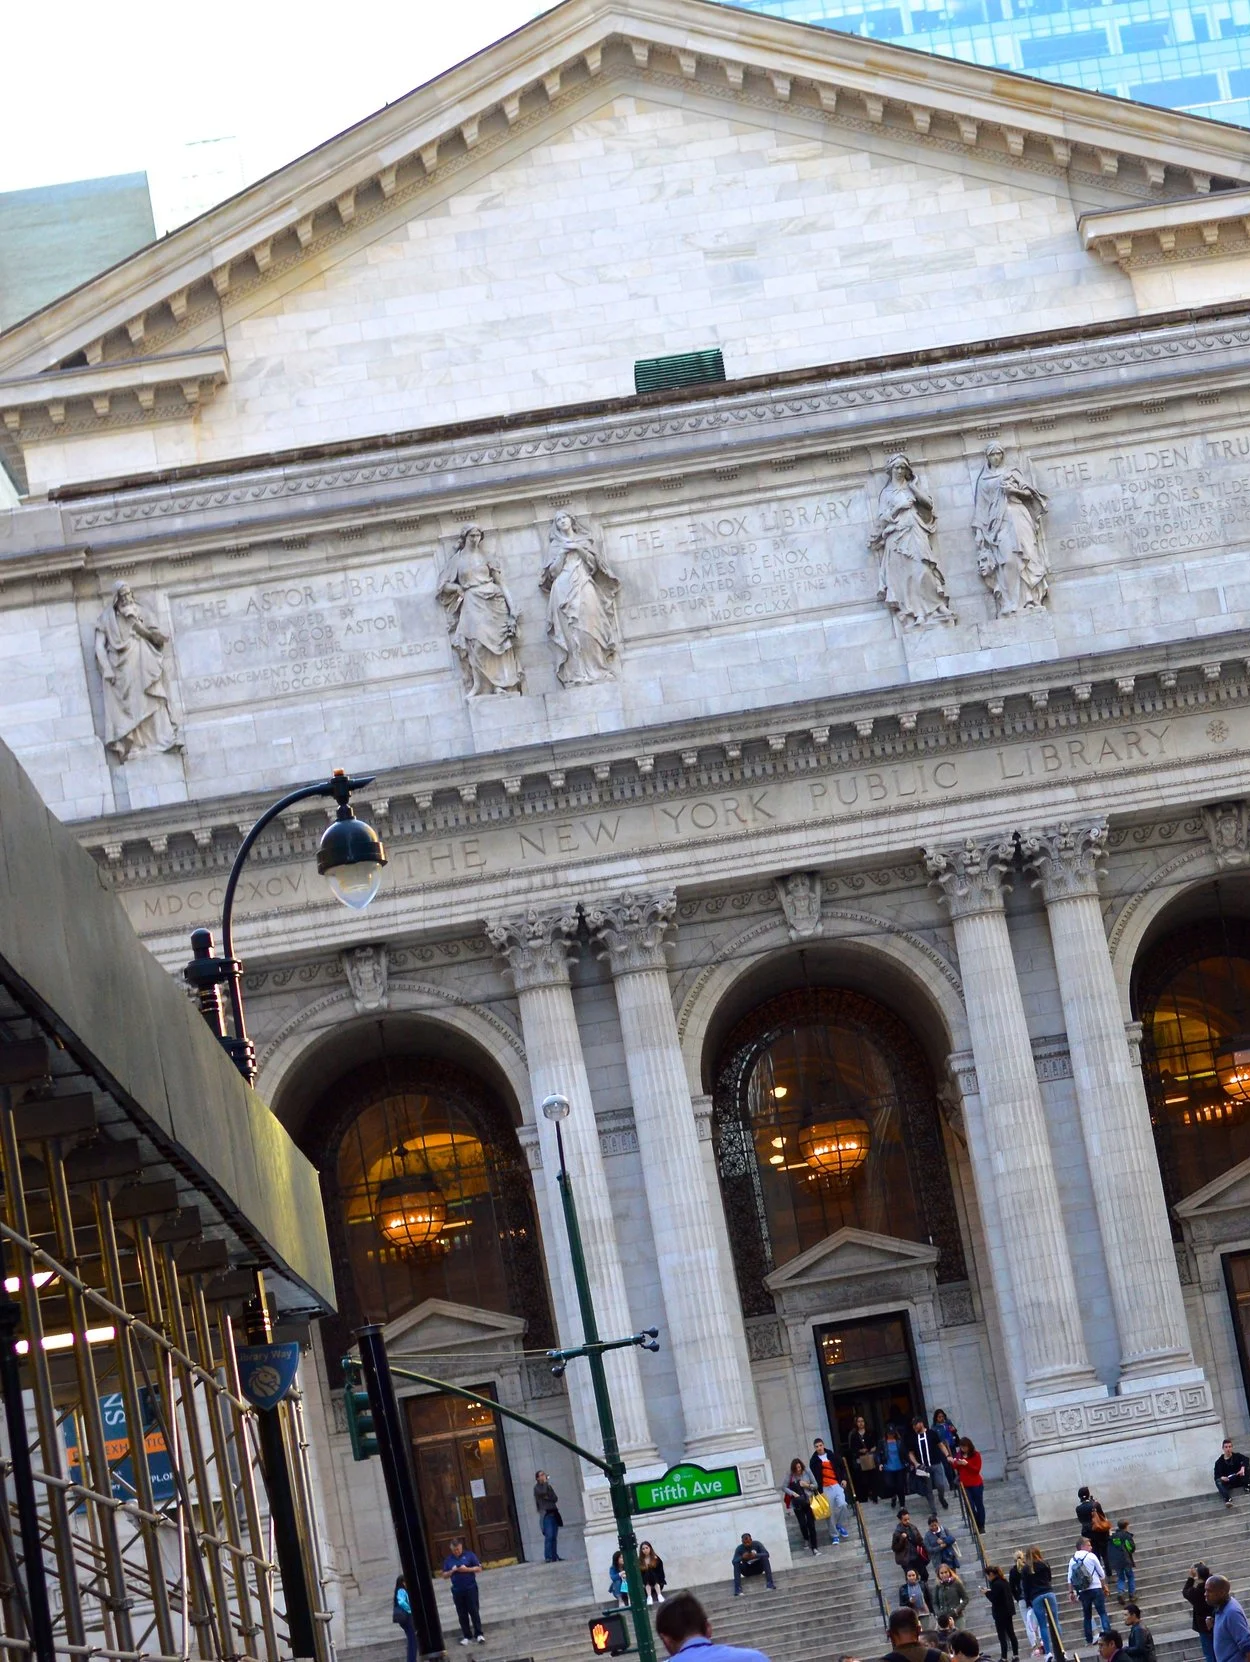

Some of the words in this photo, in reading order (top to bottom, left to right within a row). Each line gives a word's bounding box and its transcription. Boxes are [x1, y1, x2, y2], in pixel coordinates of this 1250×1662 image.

[1048, 462, 1091, 487] THE
[1109, 446, 1189, 476] TILDEN
[1121, 476, 1183, 494] FOUNDED
[1198, 471, 1212, 483] BY
[1080, 497, 1142, 518] SAMUEL
[1150, 486, 1200, 506] JONES
[619, 529, 664, 551] THE
[677, 516, 750, 548] LENOX
[761, 499, 853, 532] LIBRARY
[1098, 514, 1136, 529] SERVE
[1144, 509, 1170, 522] THE
[1154, 517, 1213, 536] POPULAR
[678, 560, 736, 582] JAMES
[751, 548, 810, 571] LENOX
[693, 544, 758, 563] FOUNDED
[773, 538, 788, 550] BY
[184, 600, 231, 622] THE
[246, 586, 316, 615] ASTOR
[328, 569, 421, 601] LIBRARY
[629, 593, 715, 620] LITERATURE
[763, 585, 789, 597] THE
[796, 579, 826, 593] FINE
[658, 578, 734, 600] DEDICATED
[743, 572, 762, 585] TO
[339, 607, 355, 621] BY
[224, 635, 270, 655] JOHN
[278, 625, 334, 647] JACOB
[344, 614, 398, 636] ASTOR
[363, 641, 439, 663] KNOWLEDGE
[395, 838, 488, 879] THE
[516, 815, 622, 860] NEW
[660, 792, 775, 834] YORK
[807, 761, 959, 812] PUBLIC
[997, 724, 1171, 780] LIBRARY
[651, 1484, 687, 1503] Fifth
[692, 1481, 722, 1496] Ave
